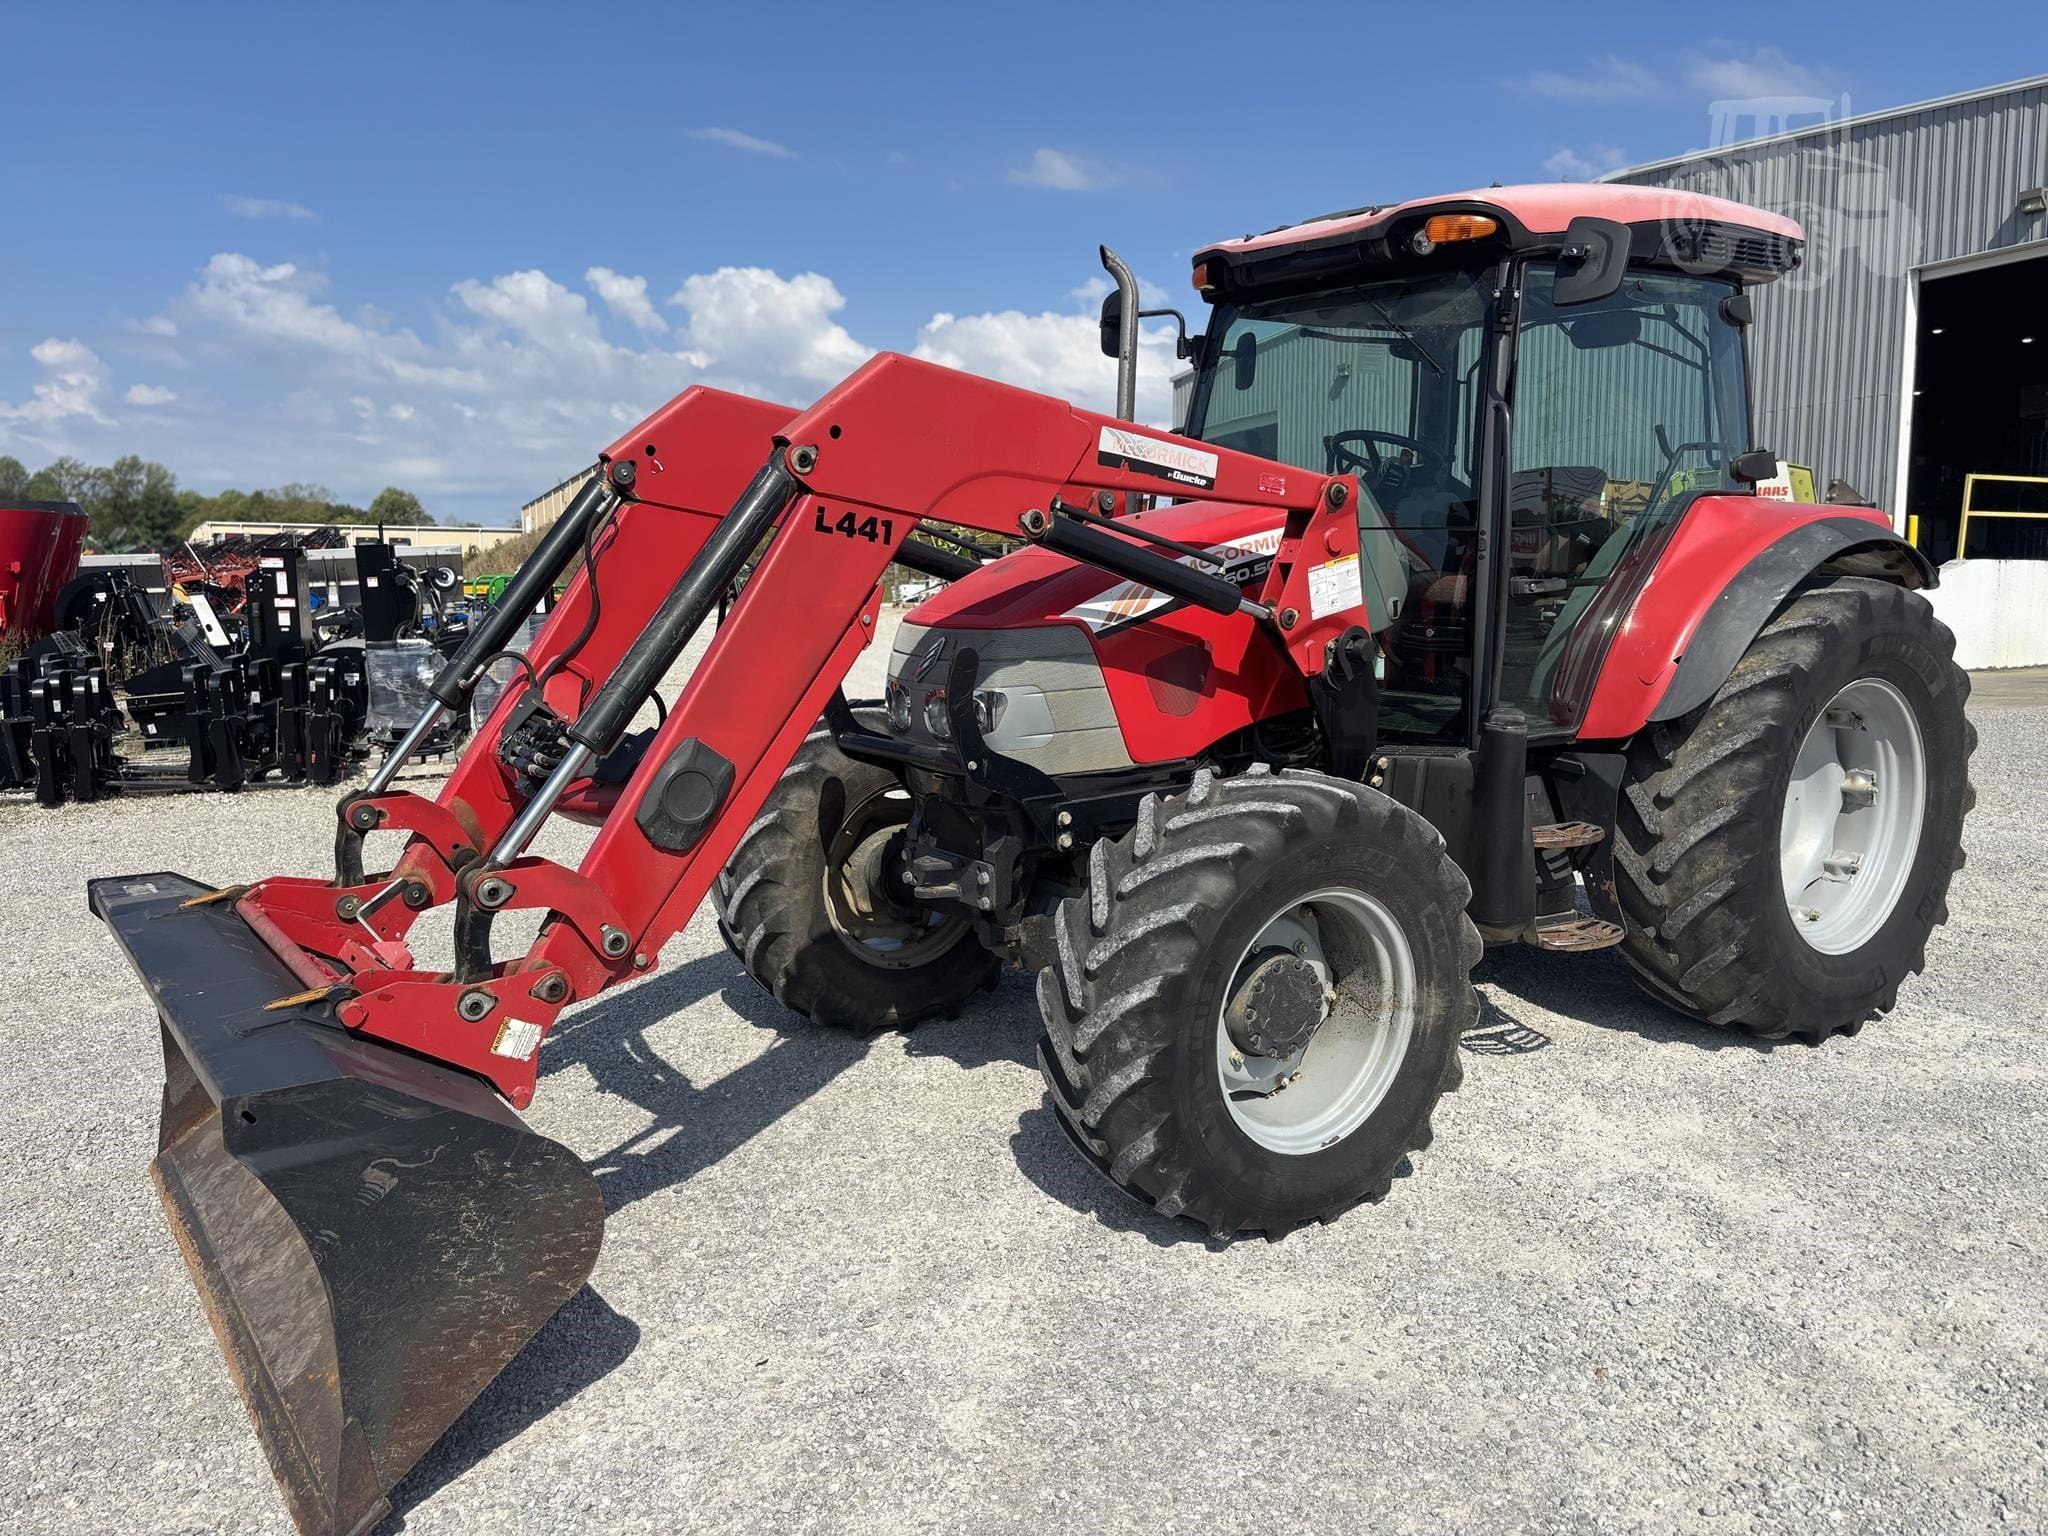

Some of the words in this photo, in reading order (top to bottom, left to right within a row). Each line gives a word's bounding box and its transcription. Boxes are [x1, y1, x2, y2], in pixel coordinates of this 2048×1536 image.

[1173, 470, 1207, 487] Quicke
[1757, 486, 1789, 497] LAAS
[814, 505, 893, 546] L441
